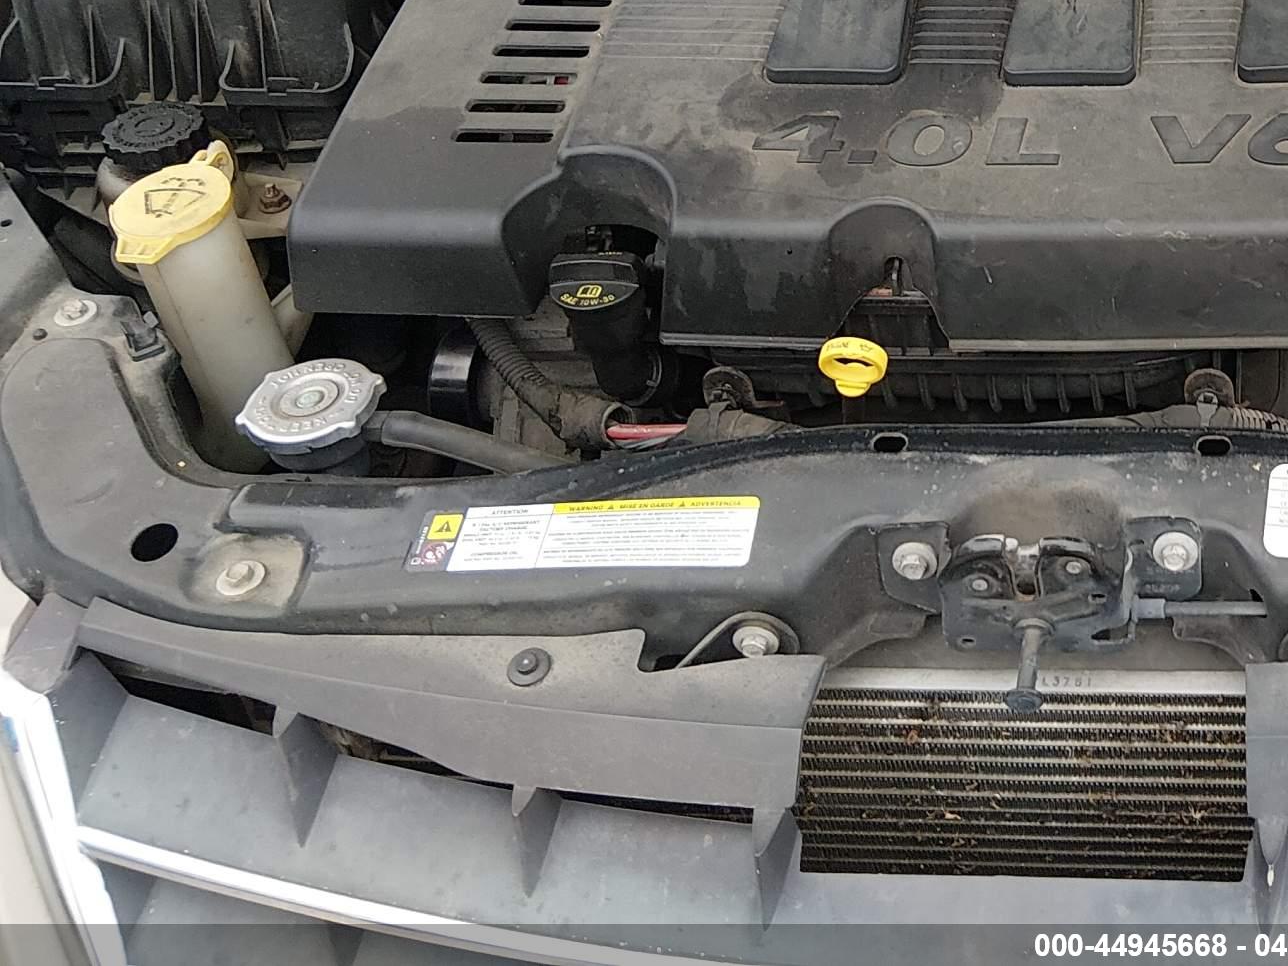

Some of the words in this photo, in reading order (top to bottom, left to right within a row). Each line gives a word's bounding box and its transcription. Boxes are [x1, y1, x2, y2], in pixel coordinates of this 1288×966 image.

[752, 114, 1060, 167] 4.0L
[560, 293, 579, 305] SAE
[580, 294, 615, 305] 10W-30
[303, 362, 346, 374] OPEN
